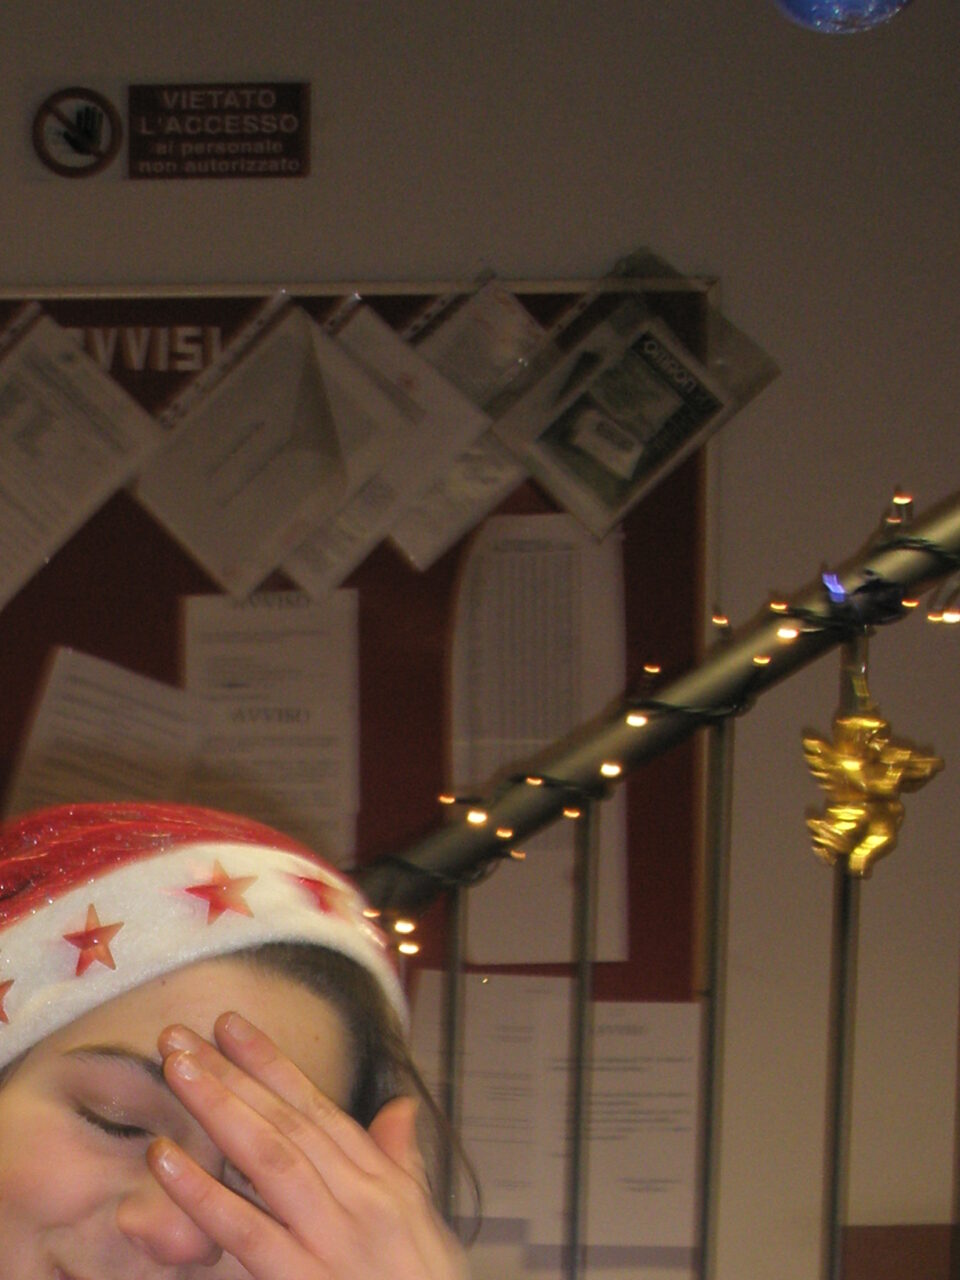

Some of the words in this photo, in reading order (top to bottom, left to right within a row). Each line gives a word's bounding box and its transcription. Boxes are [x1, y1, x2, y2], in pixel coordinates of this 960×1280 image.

[161, 89, 277, 110] VIETATO
[140, 113, 300, 136] L'ACCESSO
[181, 138, 284, 157] personale
[138, 159, 178, 174] non
[183, 157, 301, 174] autorizzato
